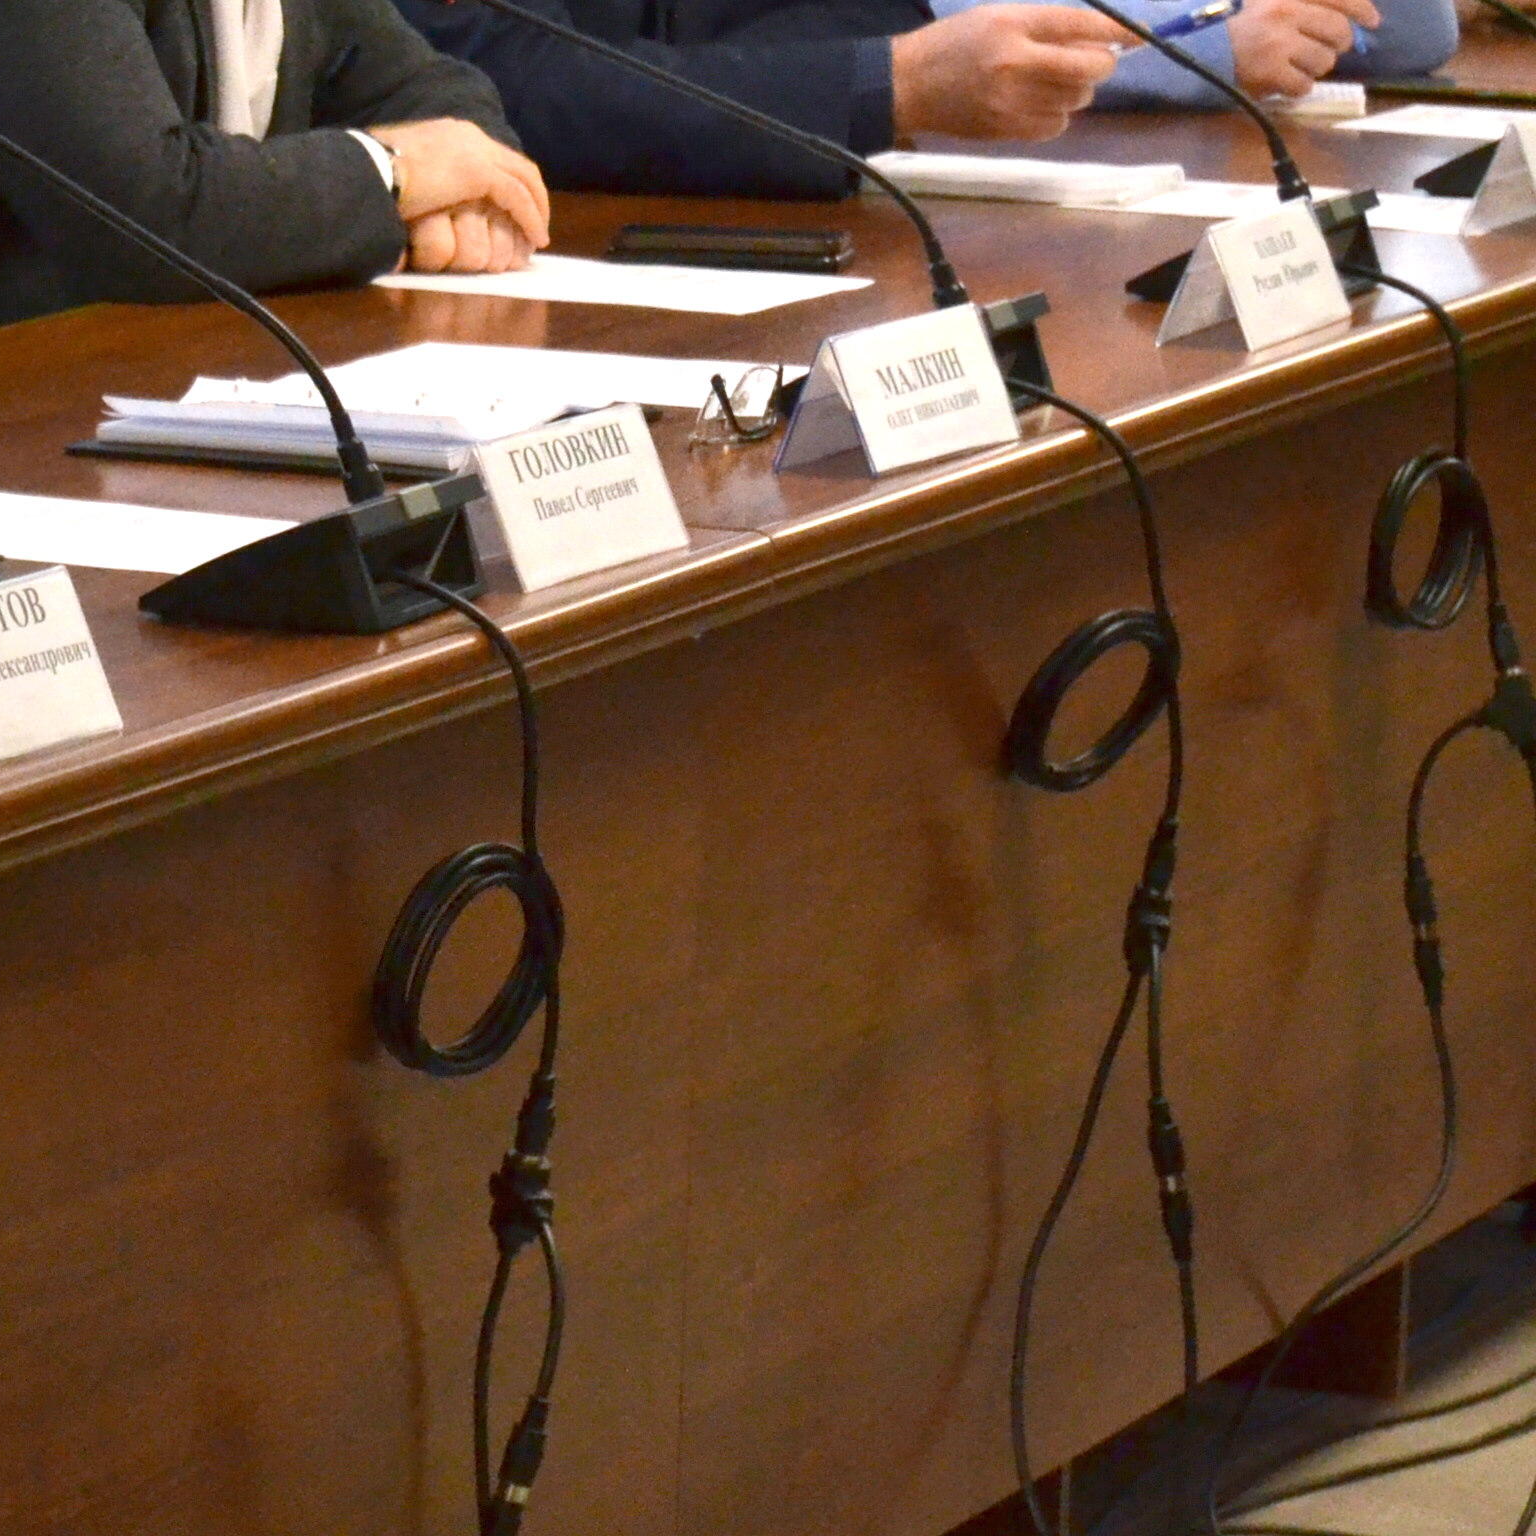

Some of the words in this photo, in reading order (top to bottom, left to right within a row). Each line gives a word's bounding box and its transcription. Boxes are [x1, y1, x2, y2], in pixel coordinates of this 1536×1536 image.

[875, 347, 966, 400] МАЛКИН
[508, 423, 631, 484] ГОЛОВКИН
[532, 496, 576, 521] Павел
[574, 477, 640, 510] Сергеевич
